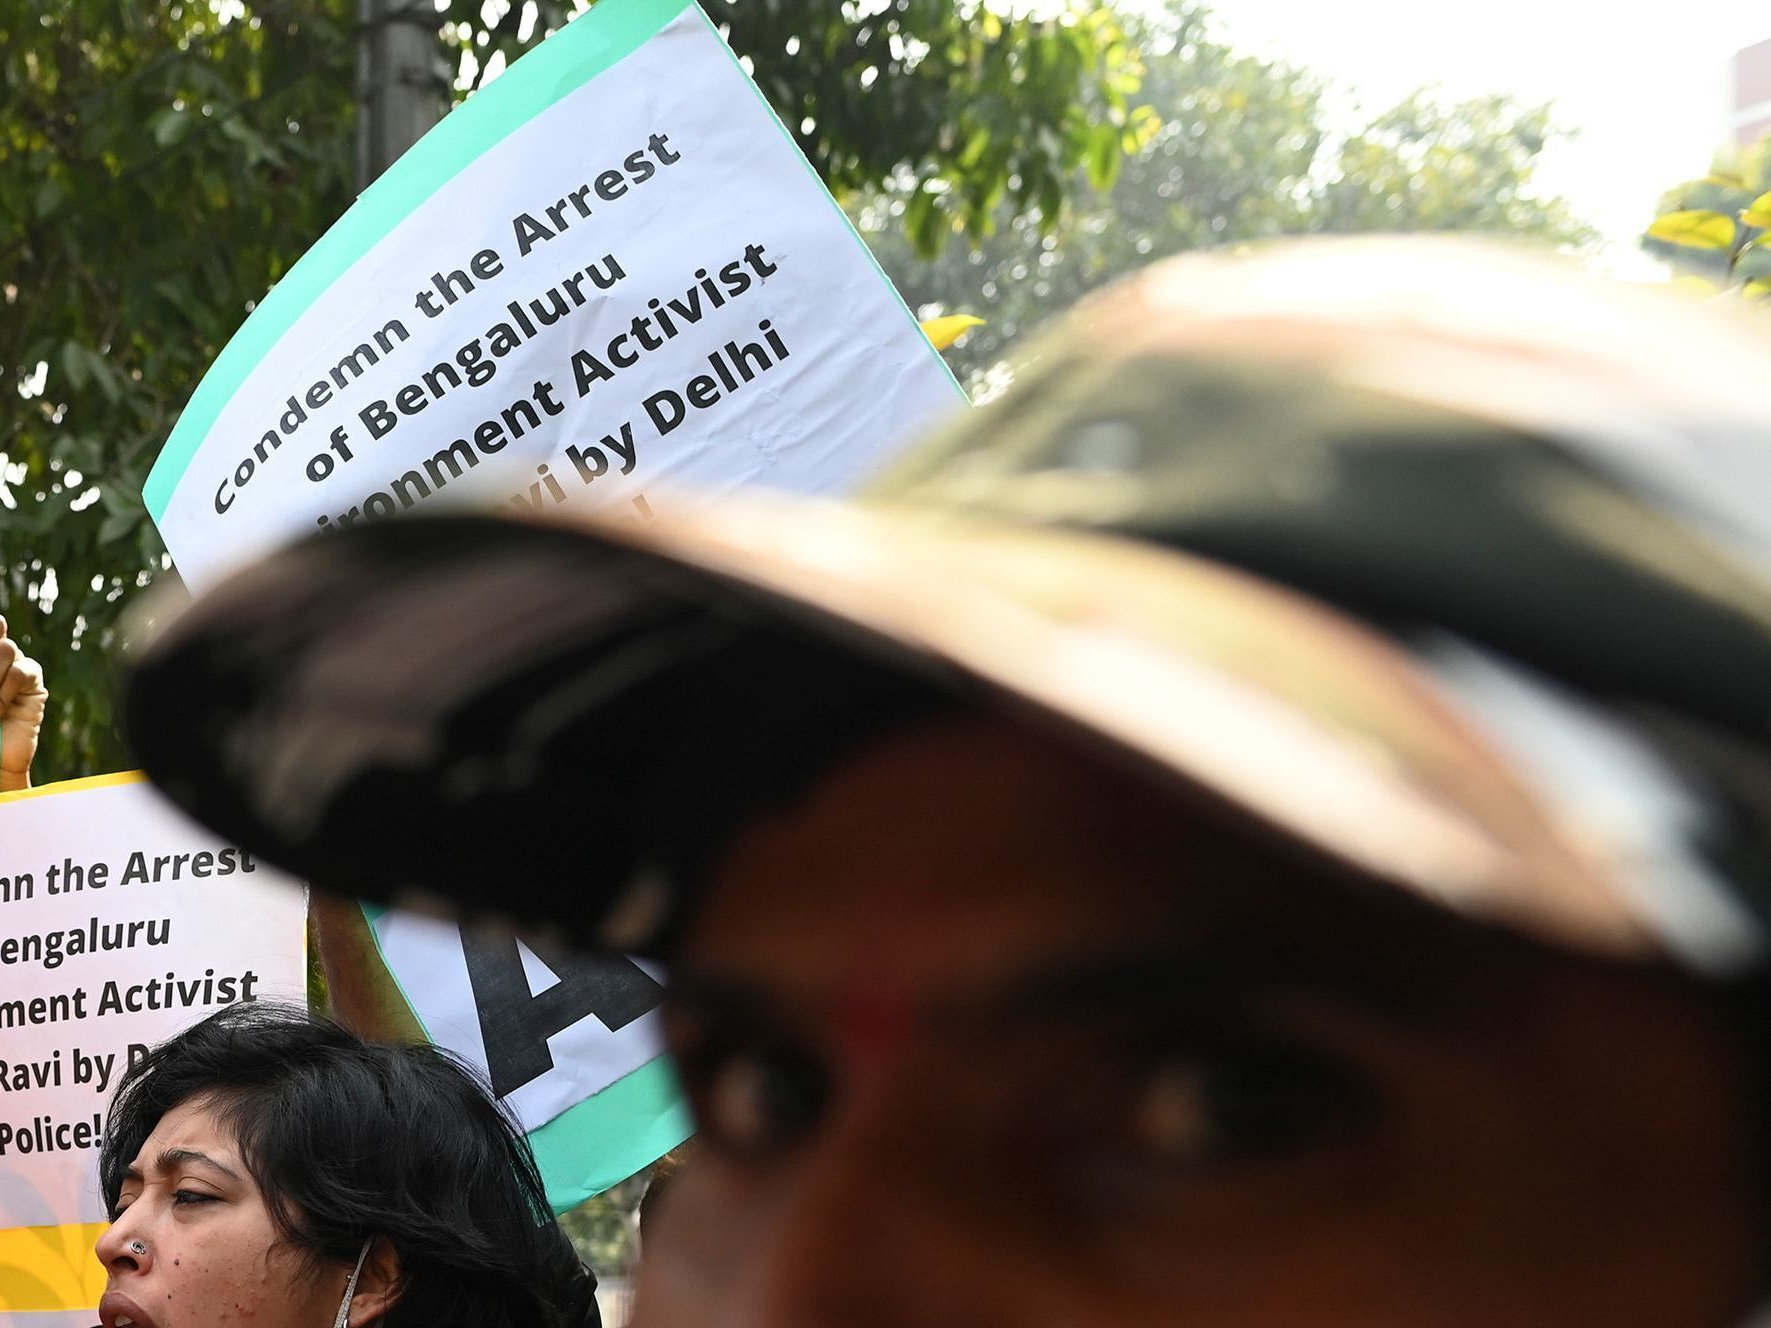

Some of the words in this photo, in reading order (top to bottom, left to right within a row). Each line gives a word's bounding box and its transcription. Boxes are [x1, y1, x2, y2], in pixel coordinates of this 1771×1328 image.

[214, 319, 411, 515] Condemn
[414, 249, 505, 318] the
[512, 133, 681, 257] Arrest
[305, 425, 354, 483] of
[357, 253, 627, 441] Bengaluru
[316, 380, 565, 536] ironment
[570, 243, 778, 399] Activist
[564, 421, 639, 476] by
[641, 318, 790, 437] Delhi
[45, 858, 109, 895] the
[120, 846, 256, 886] Arrest
[72, 1048, 116, 1093] by
[97, 968, 259, 1017] Activist
